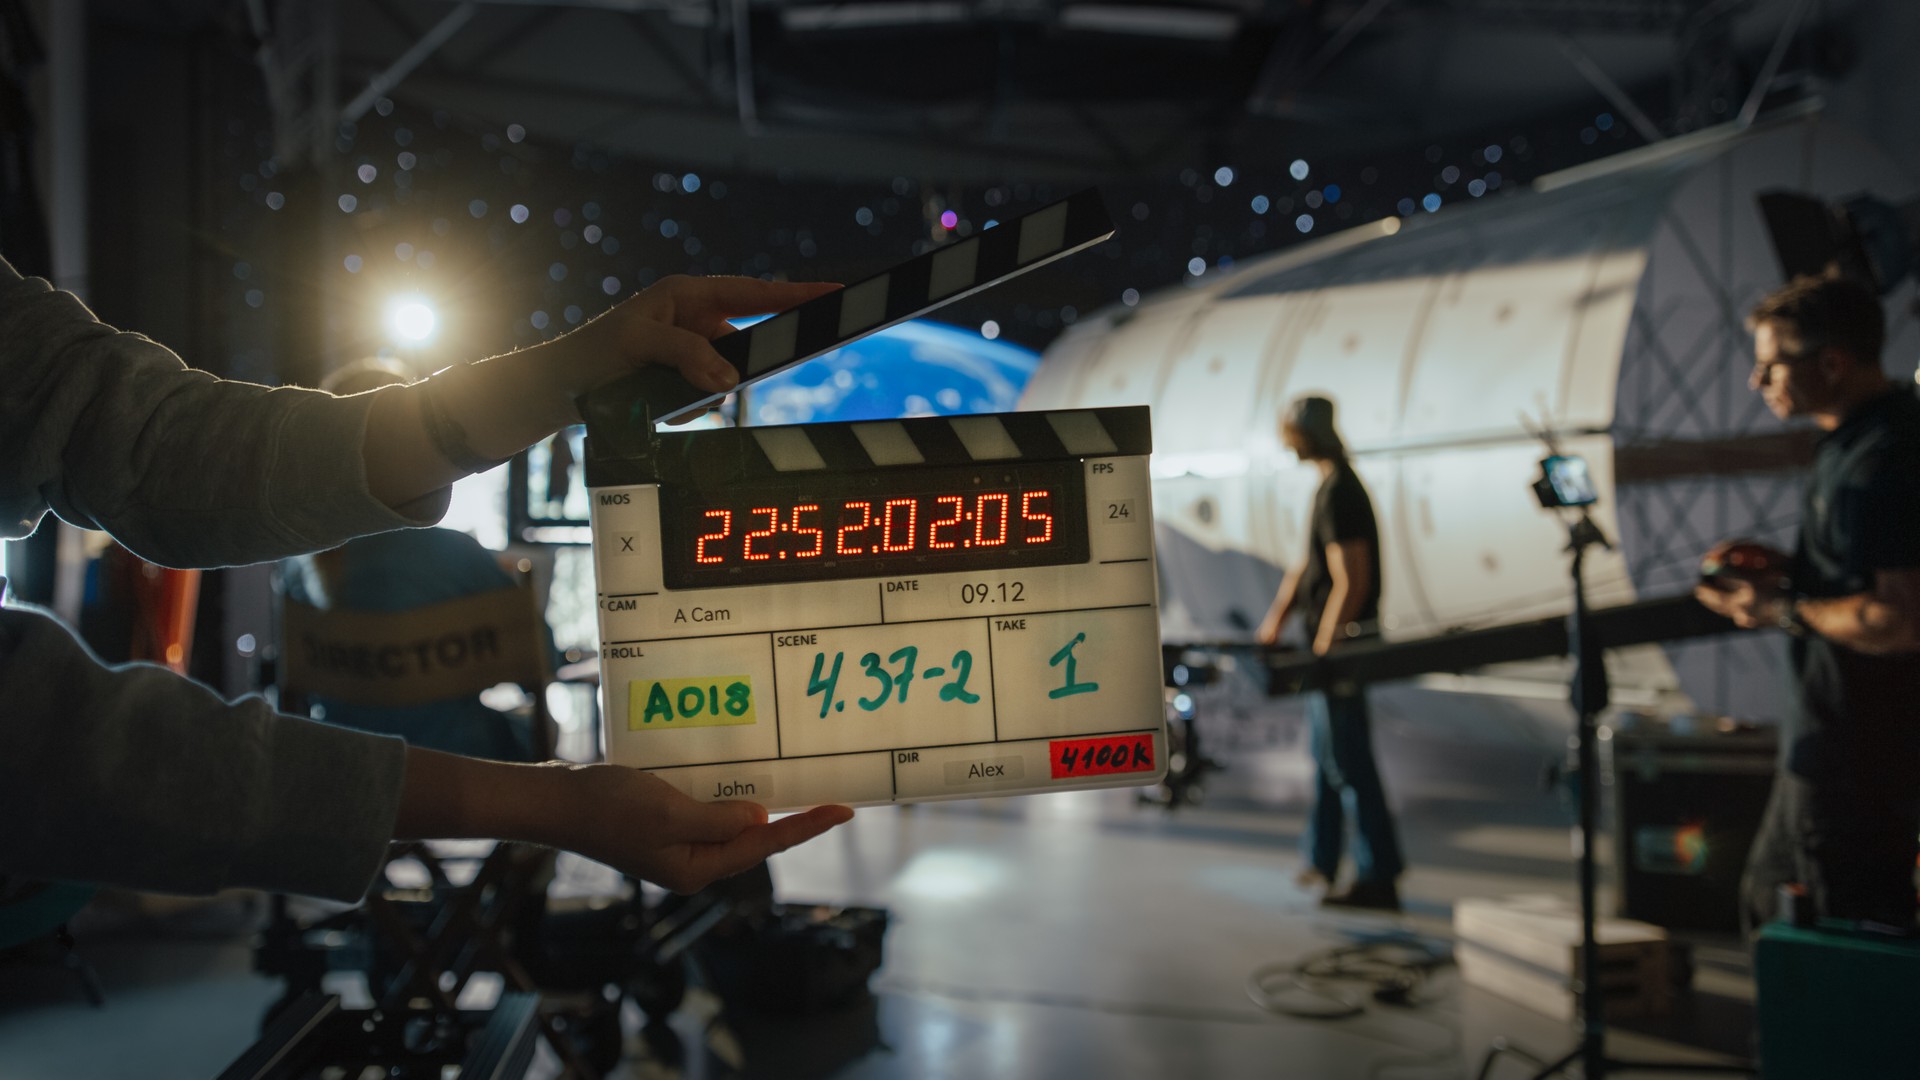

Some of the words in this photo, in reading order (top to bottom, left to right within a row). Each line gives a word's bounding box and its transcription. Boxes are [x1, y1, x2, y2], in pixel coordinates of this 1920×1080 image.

[1092, 463, 1114, 474] FPS
[600, 494, 630, 505] MOS
[1108, 504, 1129, 519] 24
[621, 536, 633, 552] X
[886, 580, 919, 593] DATE
[961, 581, 1025, 604] 09.12
[607, 599, 636, 612] CAM
[674, 609, 687, 624] A
[691, 607, 731, 622] Cam
[995, 619, 1026, 631] TAKE
[777, 634, 817, 647] SCENE
[301, 622, 499, 679] DIRECTOR
[611, 646, 644, 659] ROLL
[807, 645, 980, 719] 4.37-2
[898, 752, 919, 763] DIR
[968, 763, 1004, 779] Alex
[713, 781, 755, 798] John
